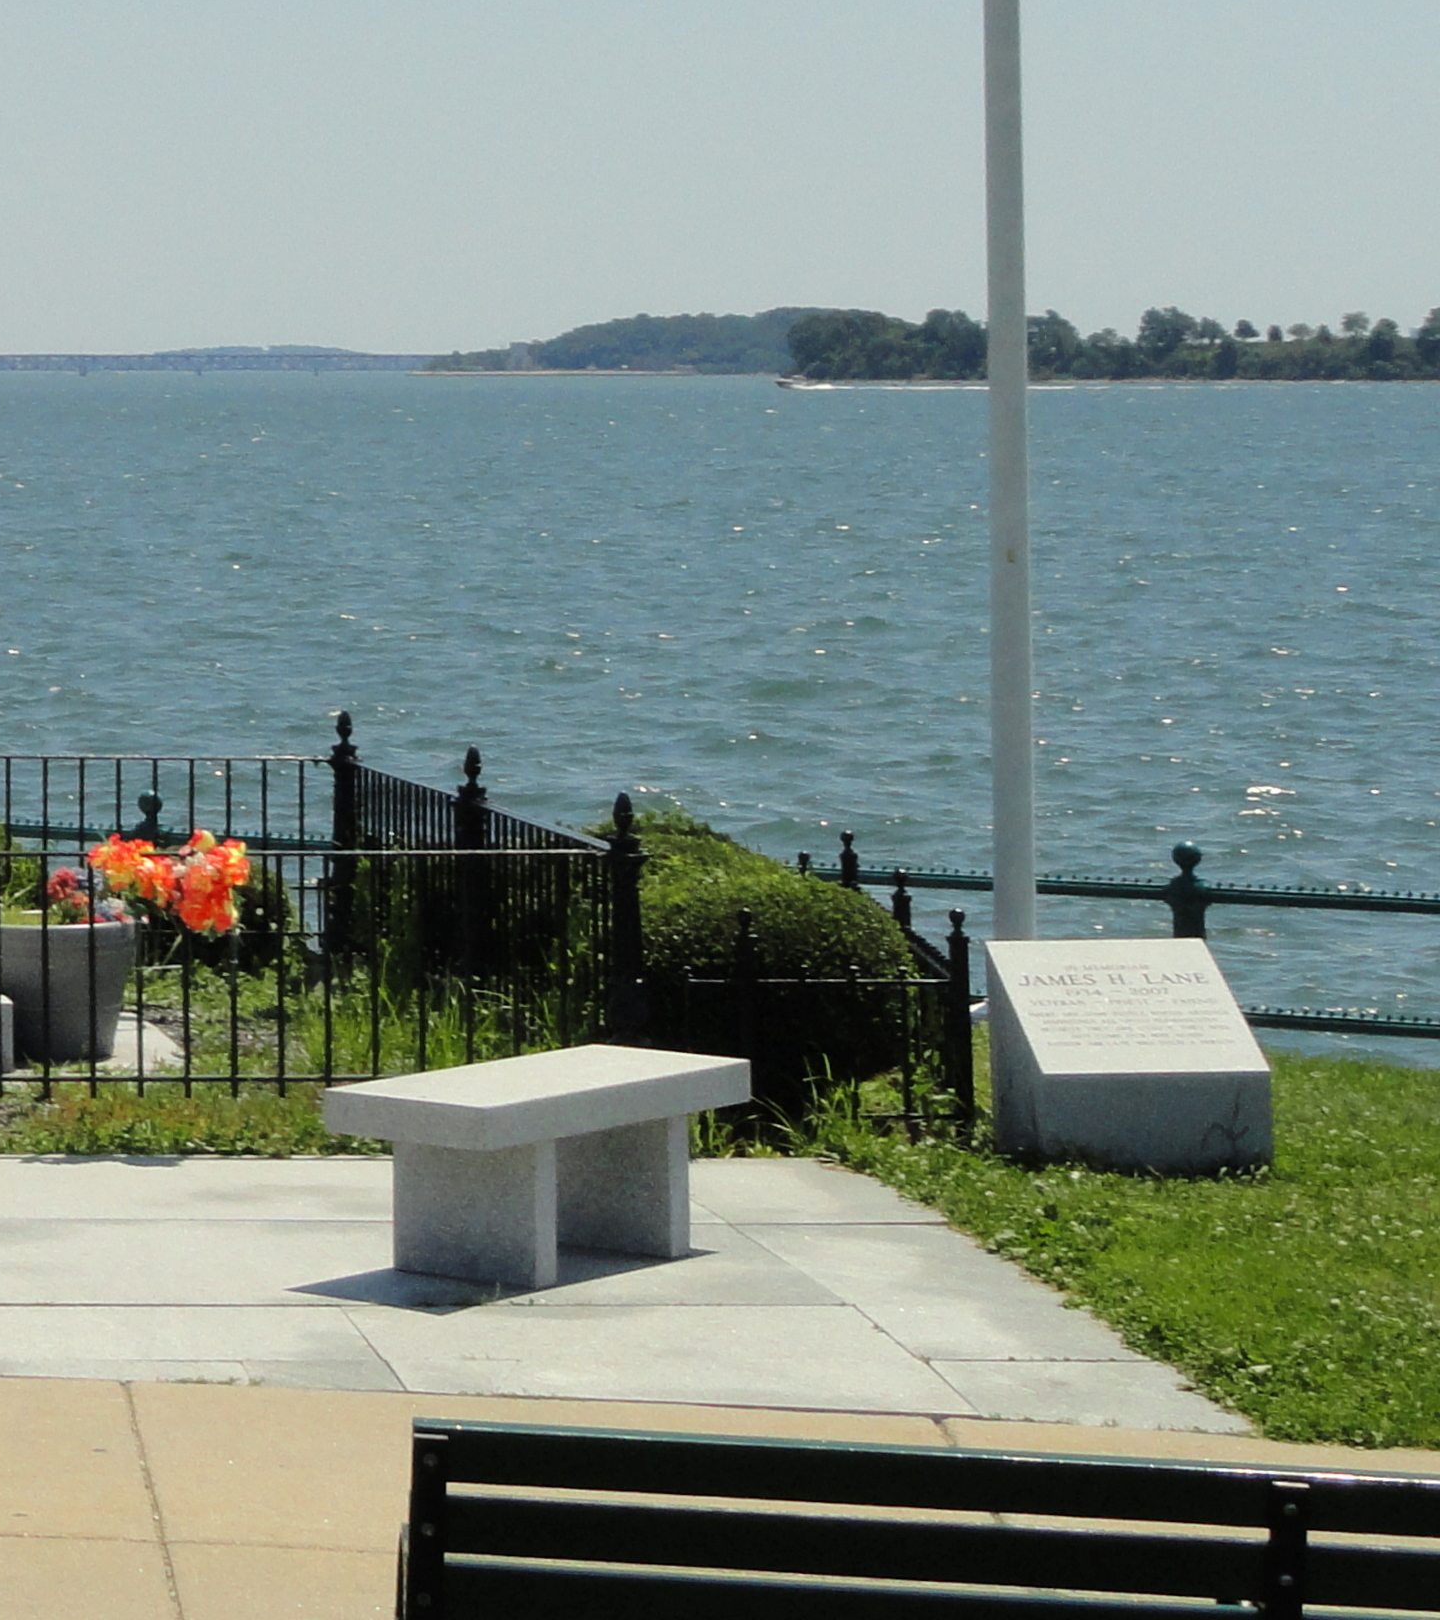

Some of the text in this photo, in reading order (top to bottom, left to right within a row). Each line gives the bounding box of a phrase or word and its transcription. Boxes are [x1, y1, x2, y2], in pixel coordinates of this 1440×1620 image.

[1018, 972, 1210, 987] JAMES H. LANE
[1128, 987, 1170, 996] 2007
